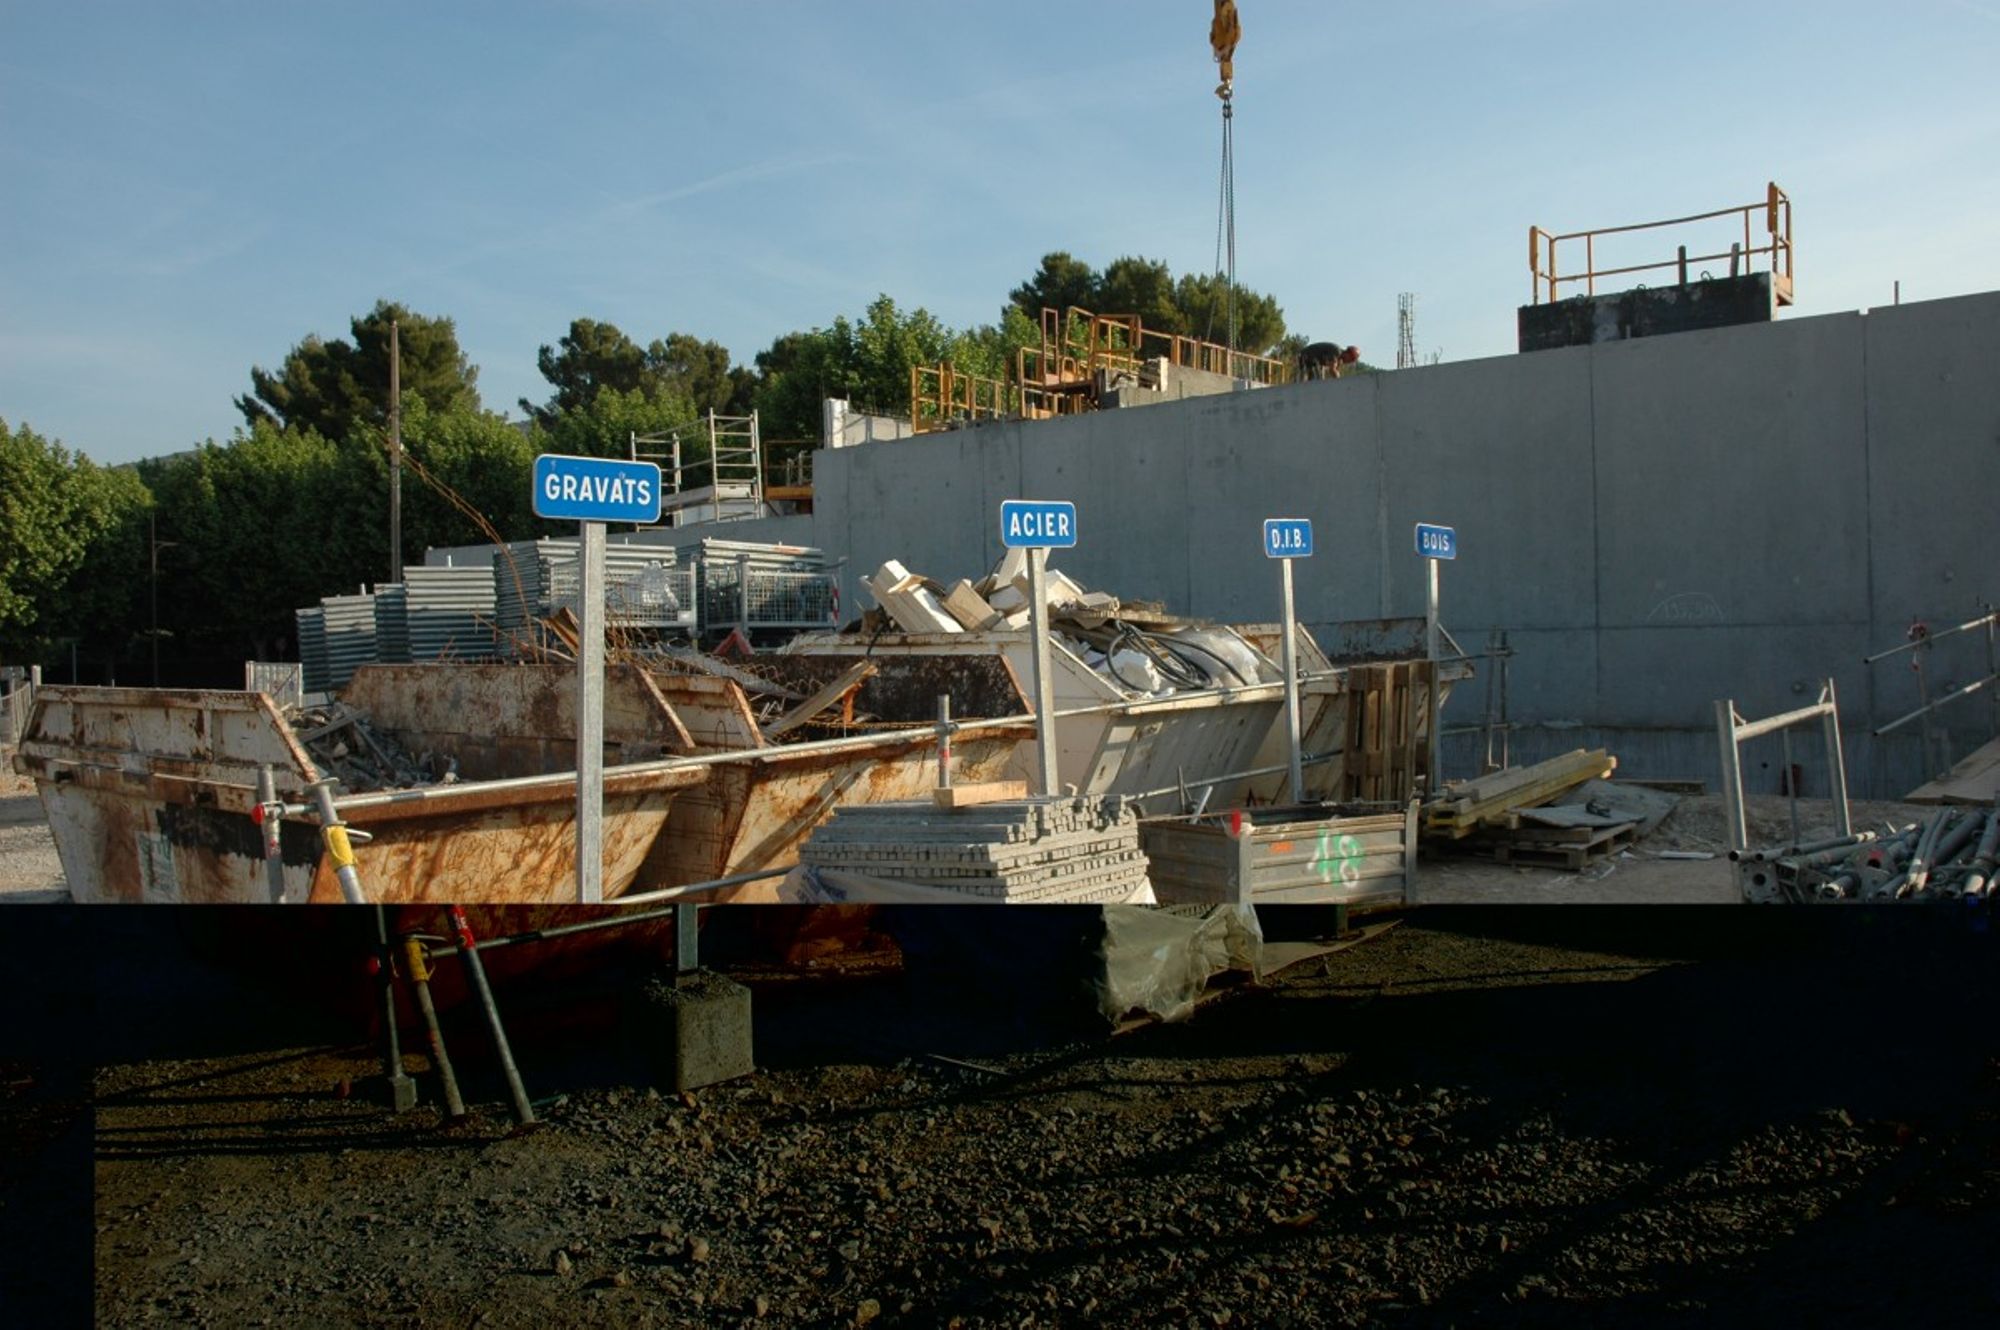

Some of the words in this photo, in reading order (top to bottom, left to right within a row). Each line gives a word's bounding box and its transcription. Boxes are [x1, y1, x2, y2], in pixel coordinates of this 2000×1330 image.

[545, 473, 651, 506] GRAVATS
[1010, 512, 1070, 537] ACIER
[1271, 528, 1307, 549] D.I.B.
[1423, 531, 1450, 552] BOIS
